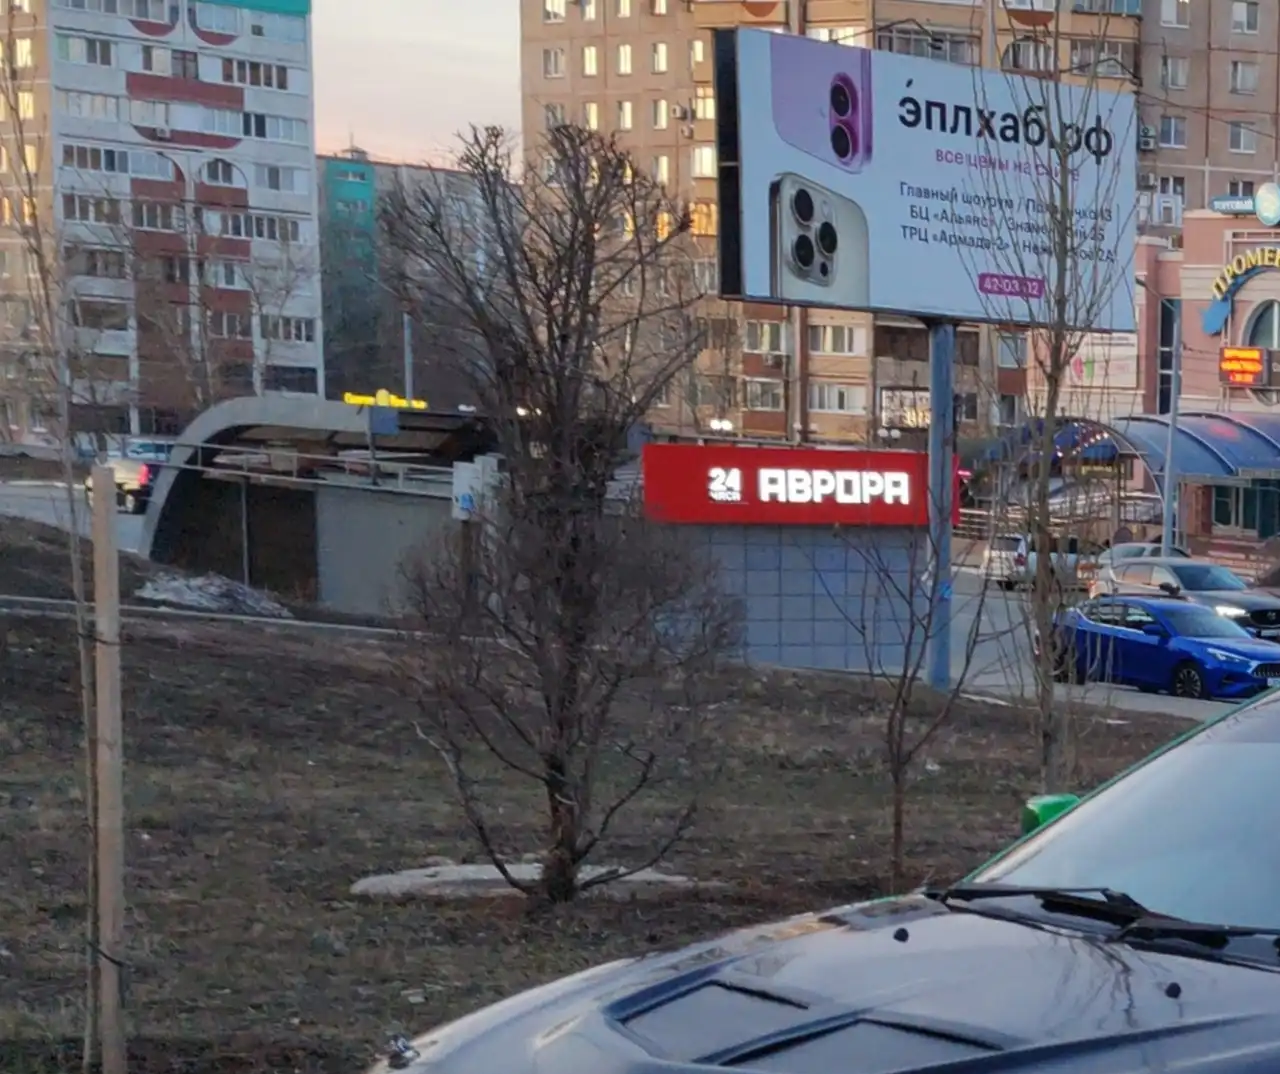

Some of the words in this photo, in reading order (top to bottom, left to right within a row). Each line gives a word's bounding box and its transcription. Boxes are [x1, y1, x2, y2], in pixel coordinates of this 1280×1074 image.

[936, 148, 964, 165] все
[910, 204, 930, 222] БЦ
[901, 225, 929, 244] ТРЦ
[708, 467, 742, 491] 24
[758, 468, 910, 505] АВРОРА
